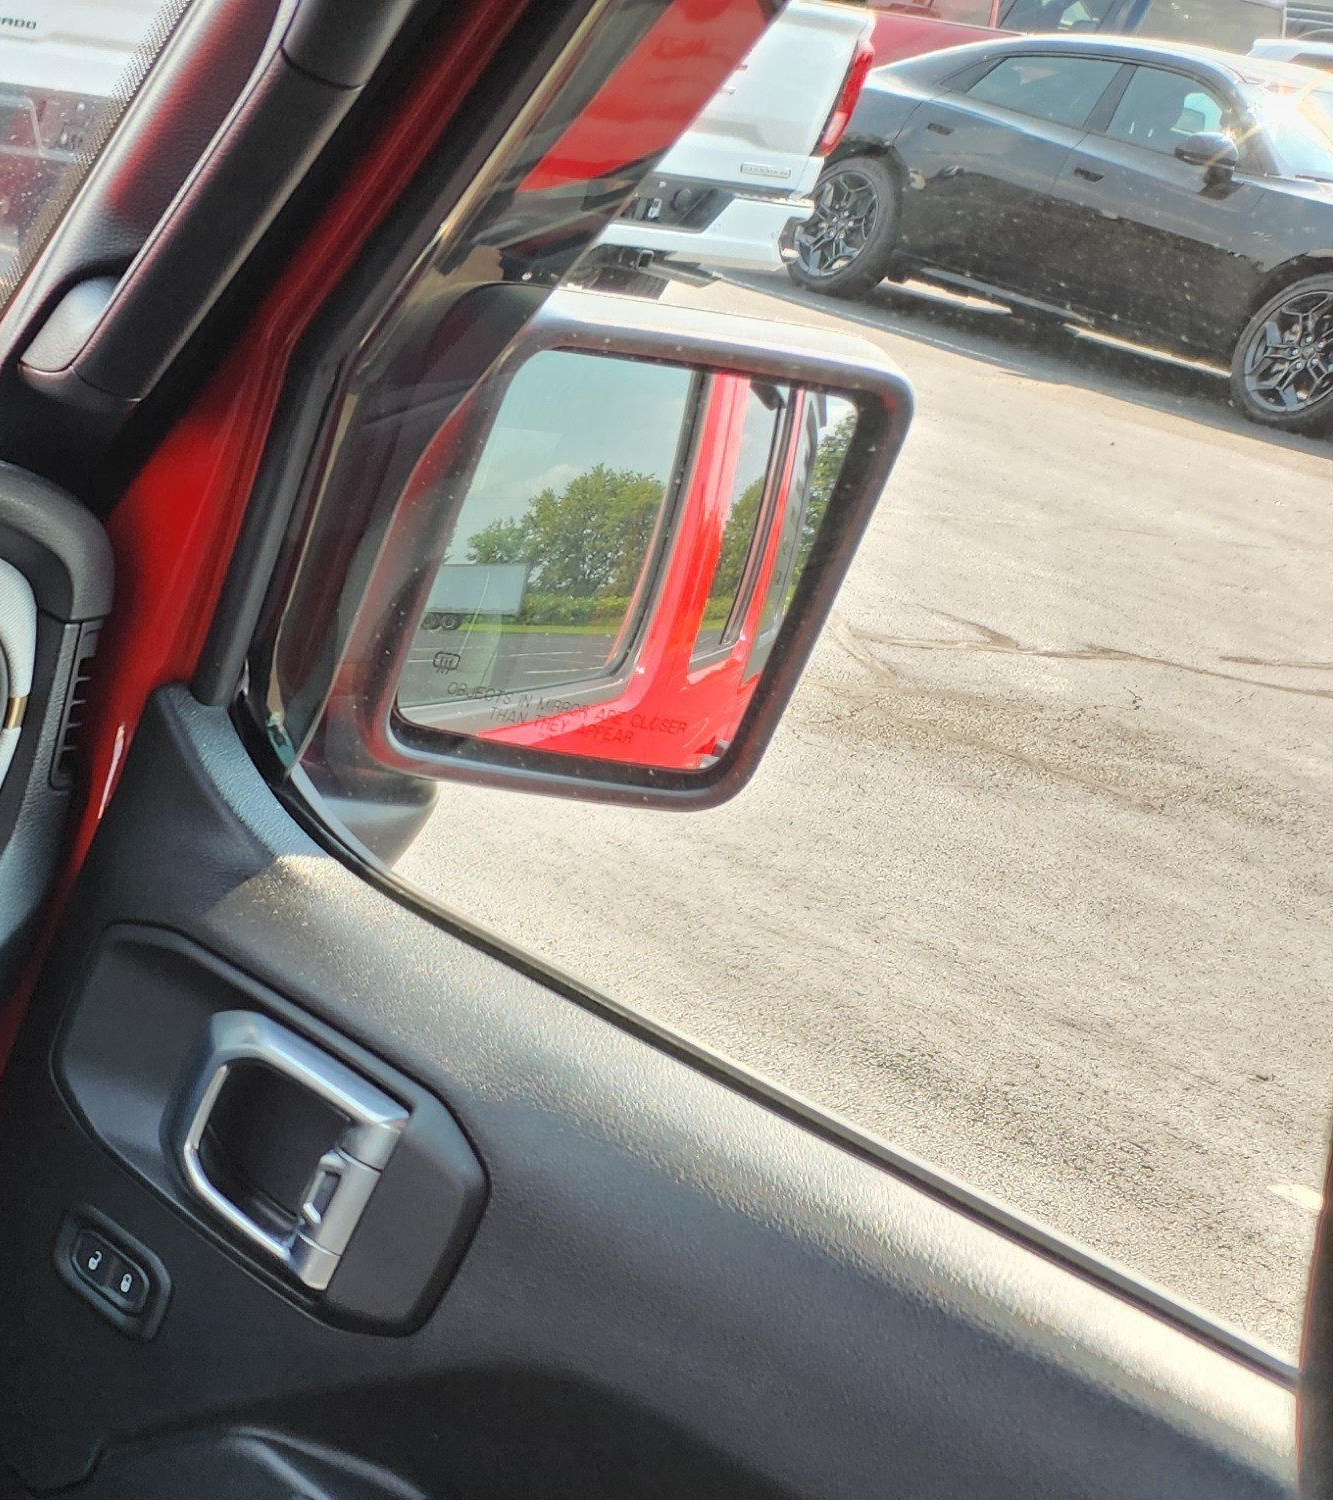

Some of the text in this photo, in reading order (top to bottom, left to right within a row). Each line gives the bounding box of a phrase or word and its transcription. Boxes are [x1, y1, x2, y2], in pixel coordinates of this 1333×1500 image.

[446, 681, 512, 705] OBJECTS
[518, 696, 531, 709] IN
[630, 714, 687, 735] CLOSER
[489, 707, 525, 724] THAN
